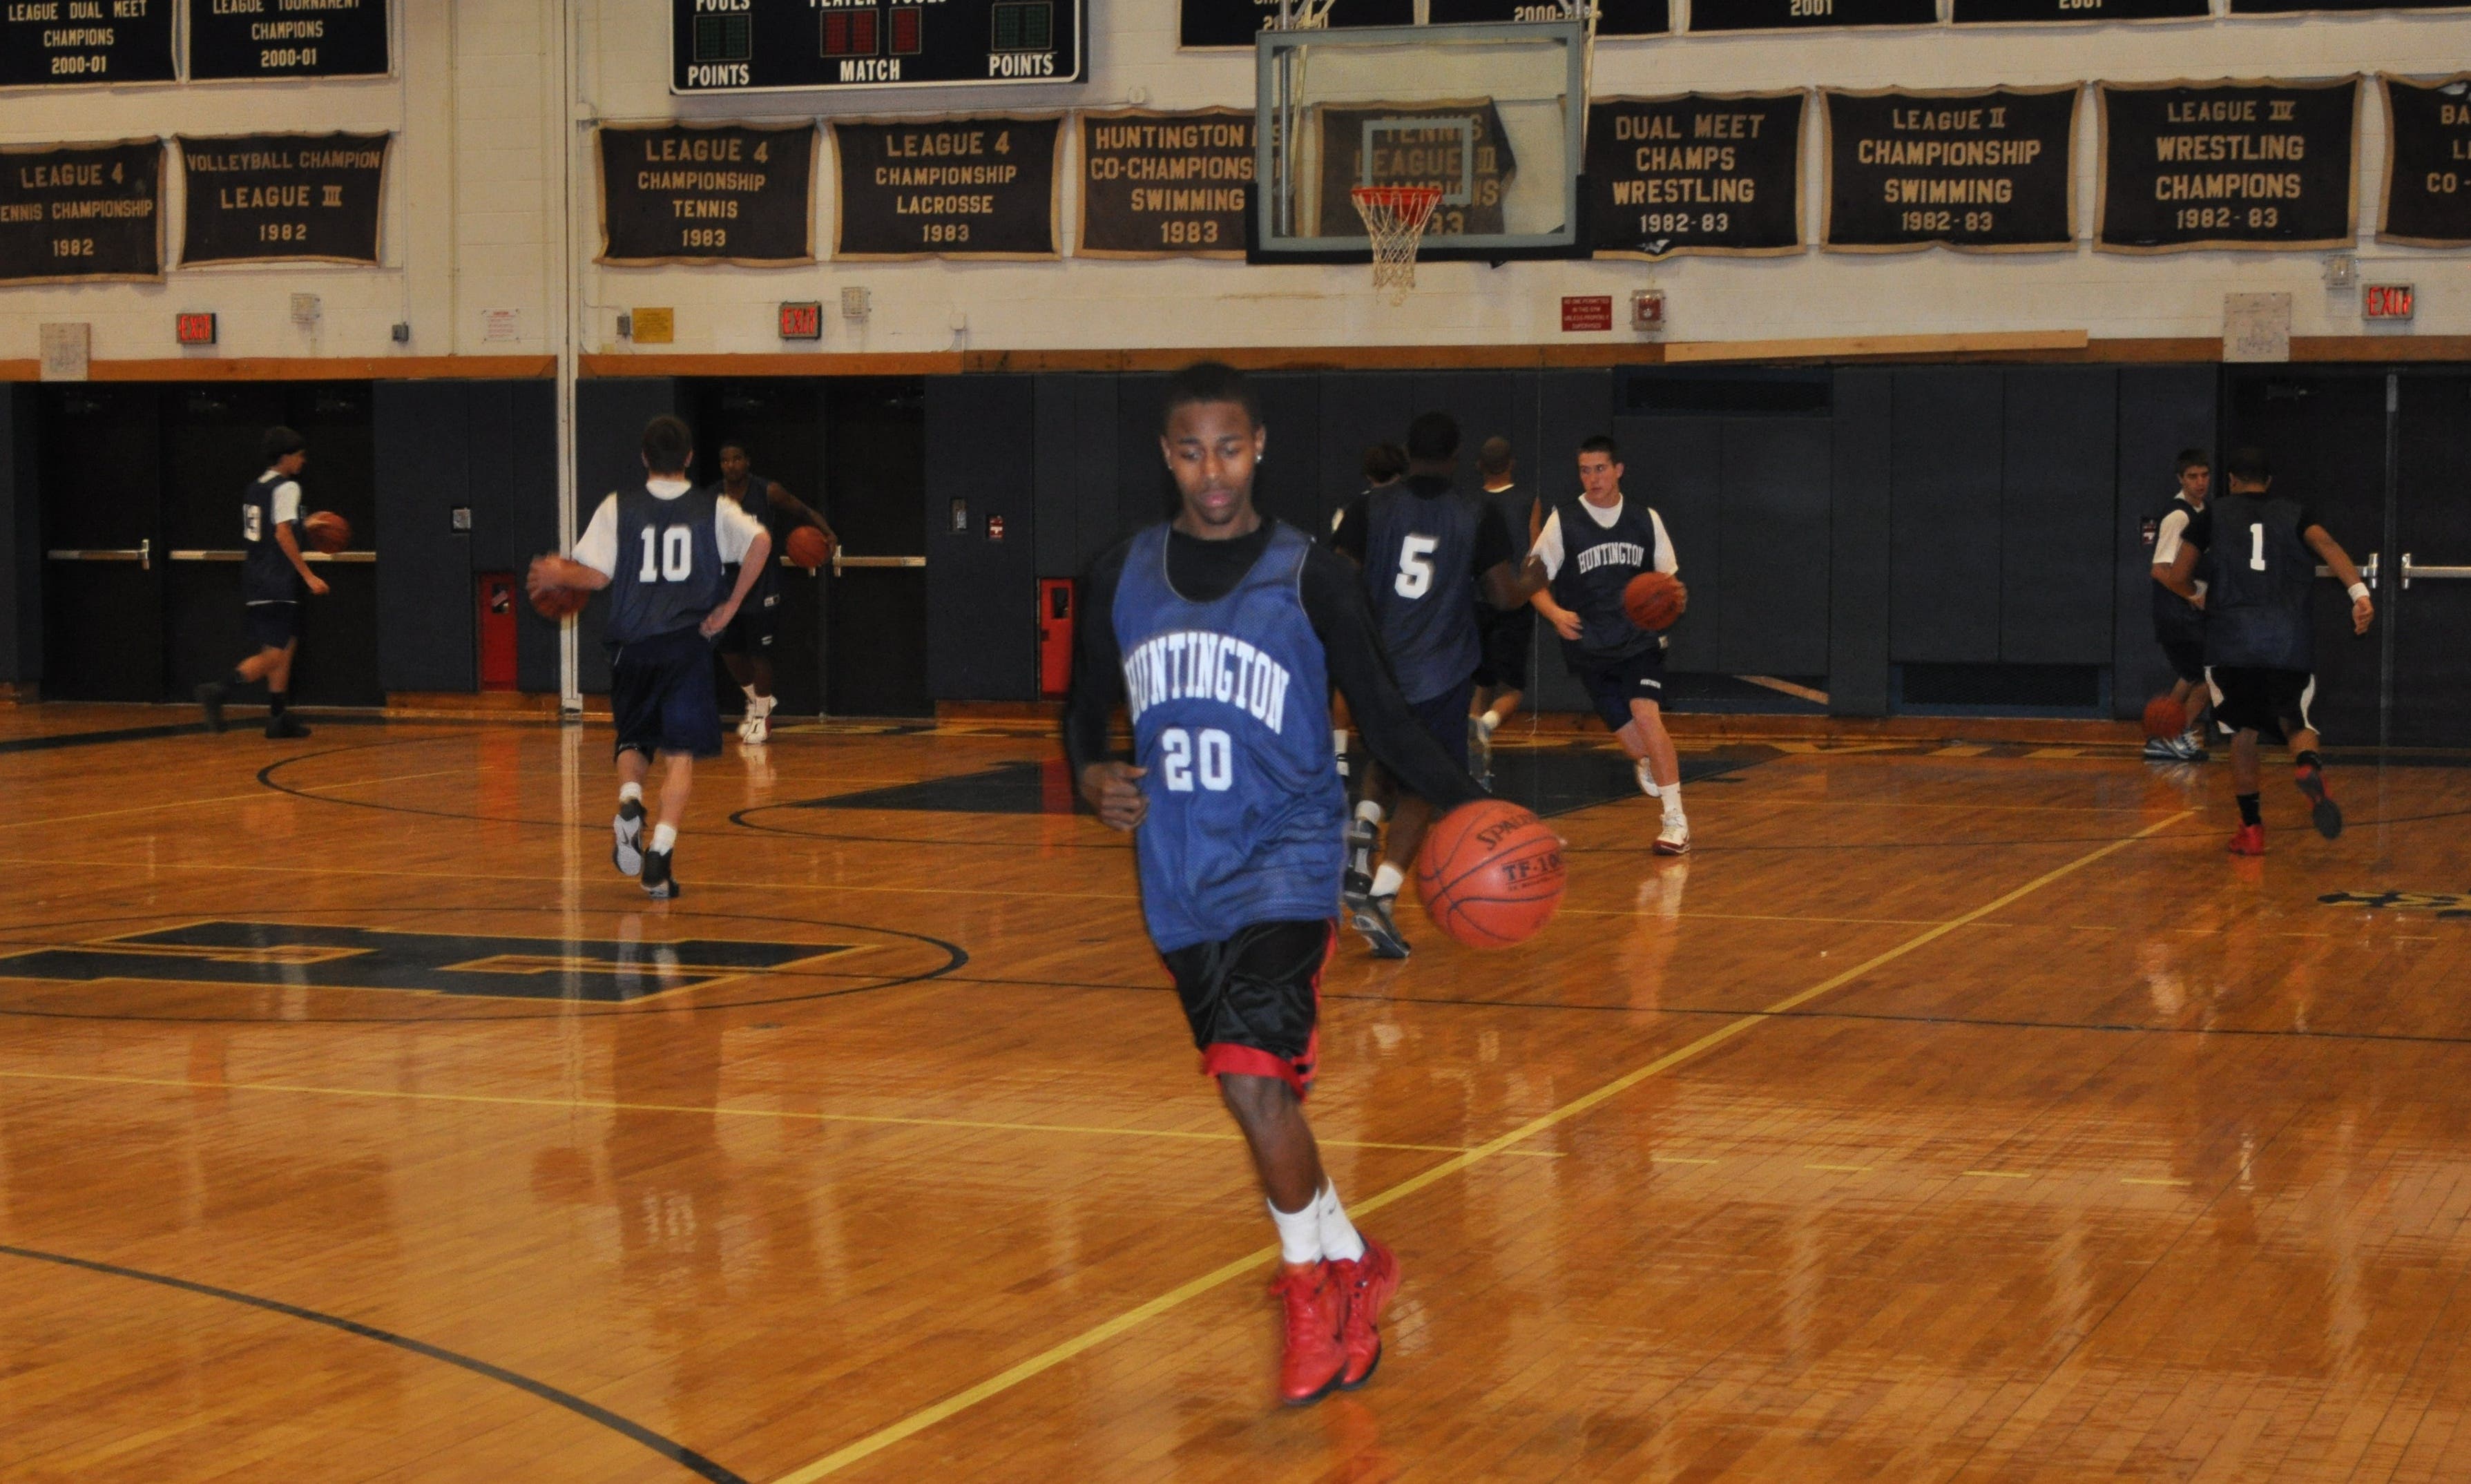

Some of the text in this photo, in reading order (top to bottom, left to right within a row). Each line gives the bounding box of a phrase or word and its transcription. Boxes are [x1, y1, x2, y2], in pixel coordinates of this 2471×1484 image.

[8, 0, 147, 21] LEAGUE DUAL MEET
[213, 0, 265, 15] LEAGUE
[1790, 0, 1833, 17] 2001
[44, 28, 114, 48] CHAMPIONS
[251, 21, 324, 40] CHAMPIONS
[52, 55, 106, 75] 2000-01
[261, 48, 317, 68] 2000-01
[989, 54, 1054, 77] POINTS
[688, 64, 749, 86] POINTS
[840, 59, 901, 81] MATCH
[1893, 108, 1982, 130] LEAGUE
[2168, 101, 2257, 122] LEAGUE
[1095, 124, 1245, 149] HUNTINGTON
[1615, 114, 1765, 140] DUAL MEET
[646, 140, 769, 163] LEAGUE 4
[886, 131, 1010, 157] LEAGUE 4
[1858, 140, 2041, 166] CHAMPIONSHIP
[2155, 135, 2305, 162] WRESTLING
[187, 151, 380, 172] VOLLEYBALL CHAMPION
[1636, 146, 1735, 171] CHAMPS
[21, 162, 124, 189] LEAGUE 4
[638, 171, 765, 191] CHAMPIONSHIP
[875, 166, 1017, 185] CHAMPIONSHIP
[2155, 173, 2302, 200] CHAMPIONS
[220, 186, 311, 209] LEAGUE
[1131, 189, 1244, 211] SWIMMING
[1613, 178, 1755, 205] WRESTLING
[1884, 180, 2012, 204] SWIMMING
[52, 199, 153, 220] CHAMPIONSHIP
[673, 200, 738, 218] TENNIS
[897, 195, 993, 214] LACROSSE
[260, 225, 307, 241] 1982
[682, 229, 727, 247] 1983
[923, 224, 969, 242] 1983
[1160, 221, 1218, 244] 1983
[53, 238, 94, 257] 1982
[2365, 285, 2412, 316] EXIT
[179, 314, 211, 340] EXIT
[781, 307, 817, 334] EXIT
[639, 524, 691, 582] 10
[1577, 542, 1644, 575] HUNTINGTON
[2249, 523, 2266, 571] 1
[1394, 534, 1436, 599] 5
[1124, 631, 1290, 735] HUNTINGTON
[1162, 728, 1232, 791] 20
